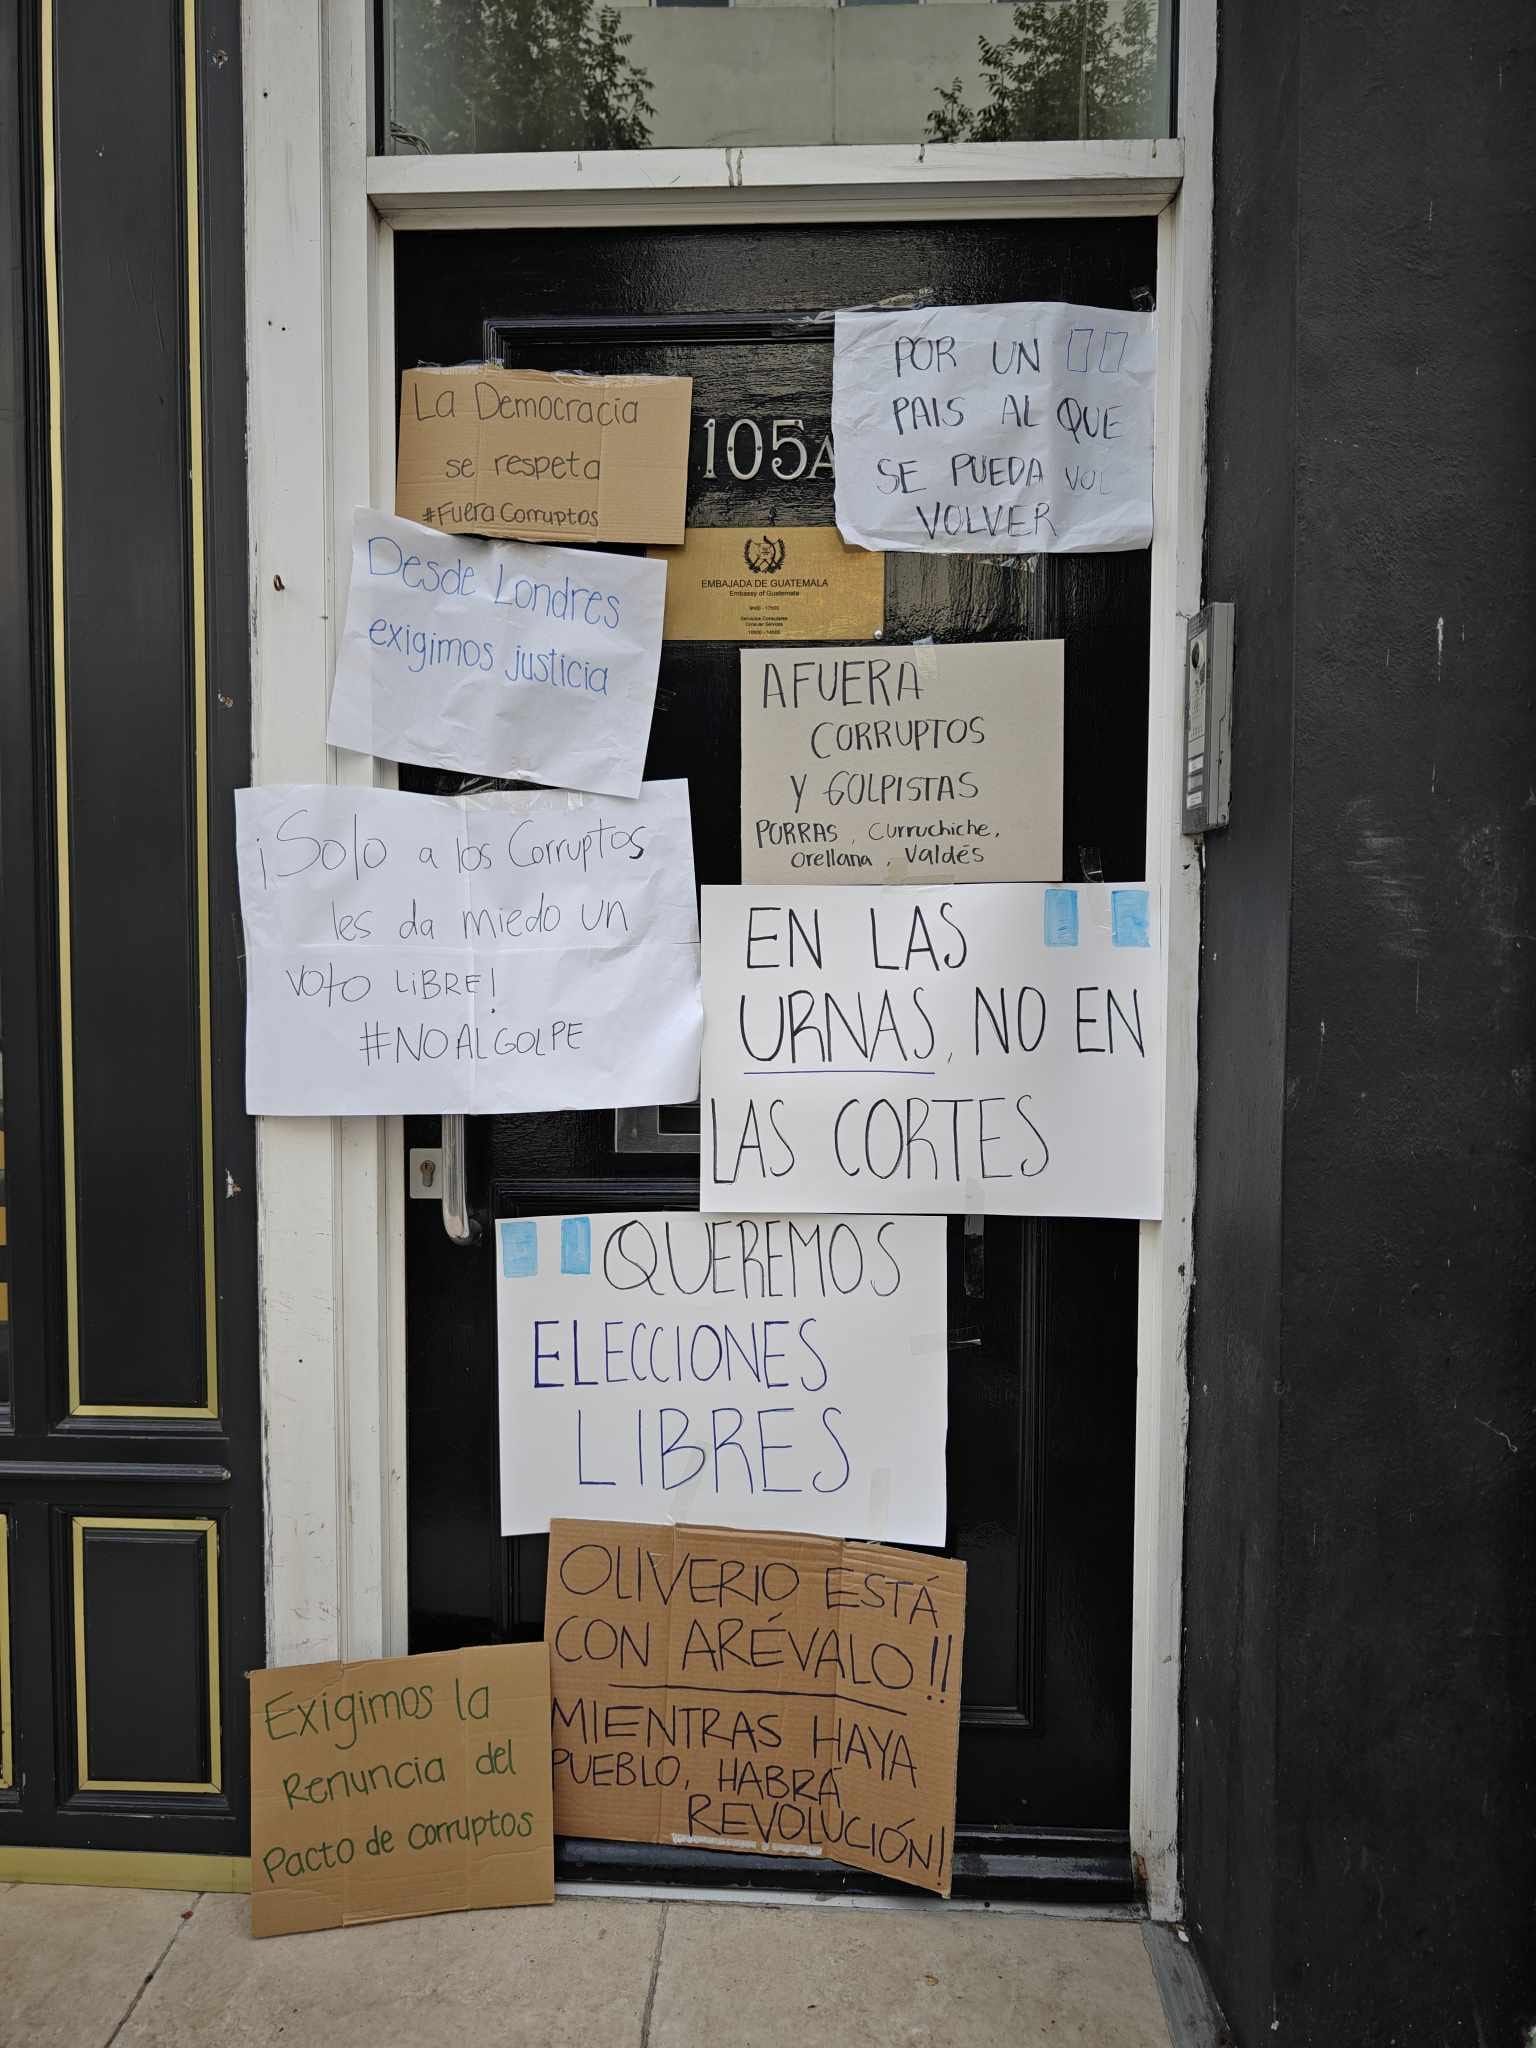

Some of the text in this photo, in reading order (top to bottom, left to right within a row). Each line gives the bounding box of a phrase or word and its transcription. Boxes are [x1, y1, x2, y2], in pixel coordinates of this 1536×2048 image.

[895, 336, 1040, 377] POR UN
[414, 382, 638, 426] La Democracia
[893, 393, 1122, 445] PAIS AL QUE
[446, 451, 600, 480] se respeta
[703, 418, 835, 480] 105A
[877, 458, 927, 495] SE
[951, 455, 1044, 487] PUEDA
[917, 501, 1057, 540] VOLVER
[368, 536, 620, 629] Desde Londres
[701, 578, 829, 589] EMBAJADA DE GUATEMALA
[369, 618, 609, 695] exigimos justicia
[763, 658, 925, 709] AFUERA
[811, 716, 985, 759] CORRUPTOS
[790, 770, 979, 814] Y GOLPISTAS
[419, 843, 439, 869] a
[456, 836, 492, 874] los
[508, 818, 647, 873] Corruptos
[332, 900, 372, 942] les
[400, 898, 434, 940] da
[462, 892, 561, 939] miedo
[746, 902, 967, 971] EN LAS
[739, 985, 1145, 1064] URNAS, NO EN
[711, 1094, 1049, 1184] LAS CORTES
[603, 1219, 901, 1299] QUEREMOS
[534, 1318, 828, 1392] ELECCIONES
[578, 1406, 850, 1494] LIBRES
[560, 1544, 940, 1629] OLIVERIO ESTÁ
[555, 1612, 952, 1704] CON ARÉVALO!!
[265, 1678, 489, 1750] Exigimos la
[551, 1697, 918, 1790] MIENTRAS HAYA
[283, 1738, 516, 1810] Renuncia del
[552, 1748, 690, 1792] PUEBLO,
[262, 1838, 354, 1883] Pacto
[366, 1825, 394, 1856] de
[688, 1793, 945, 1888] REVOLUCIÓN!
